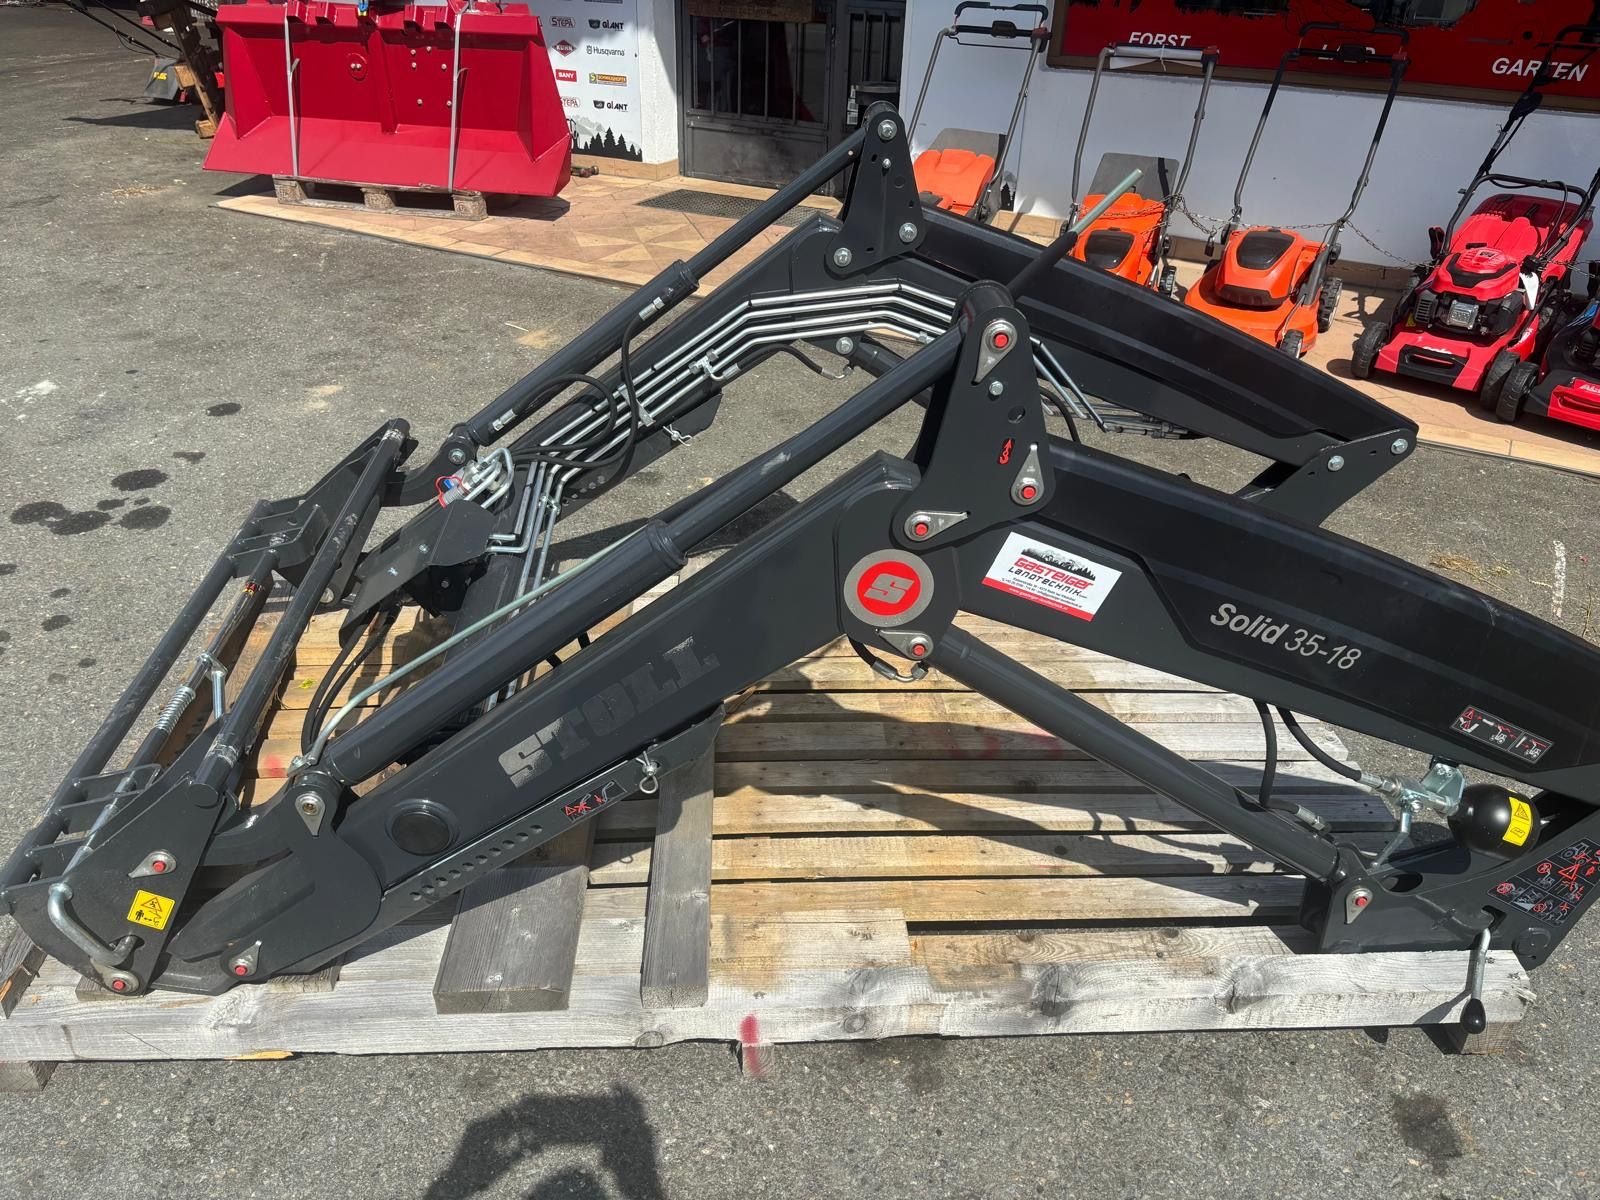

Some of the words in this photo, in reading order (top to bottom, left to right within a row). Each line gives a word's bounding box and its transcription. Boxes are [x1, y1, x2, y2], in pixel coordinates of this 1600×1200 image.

[1128, 31, 1191, 46] FORST
[593, 46, 625, 57] Husqvarna
[1491, 57, 1589, 82] GAREN
[1209, 603, 1290, 645] Solid
[1284, 628, 1362, 670] 35-18
